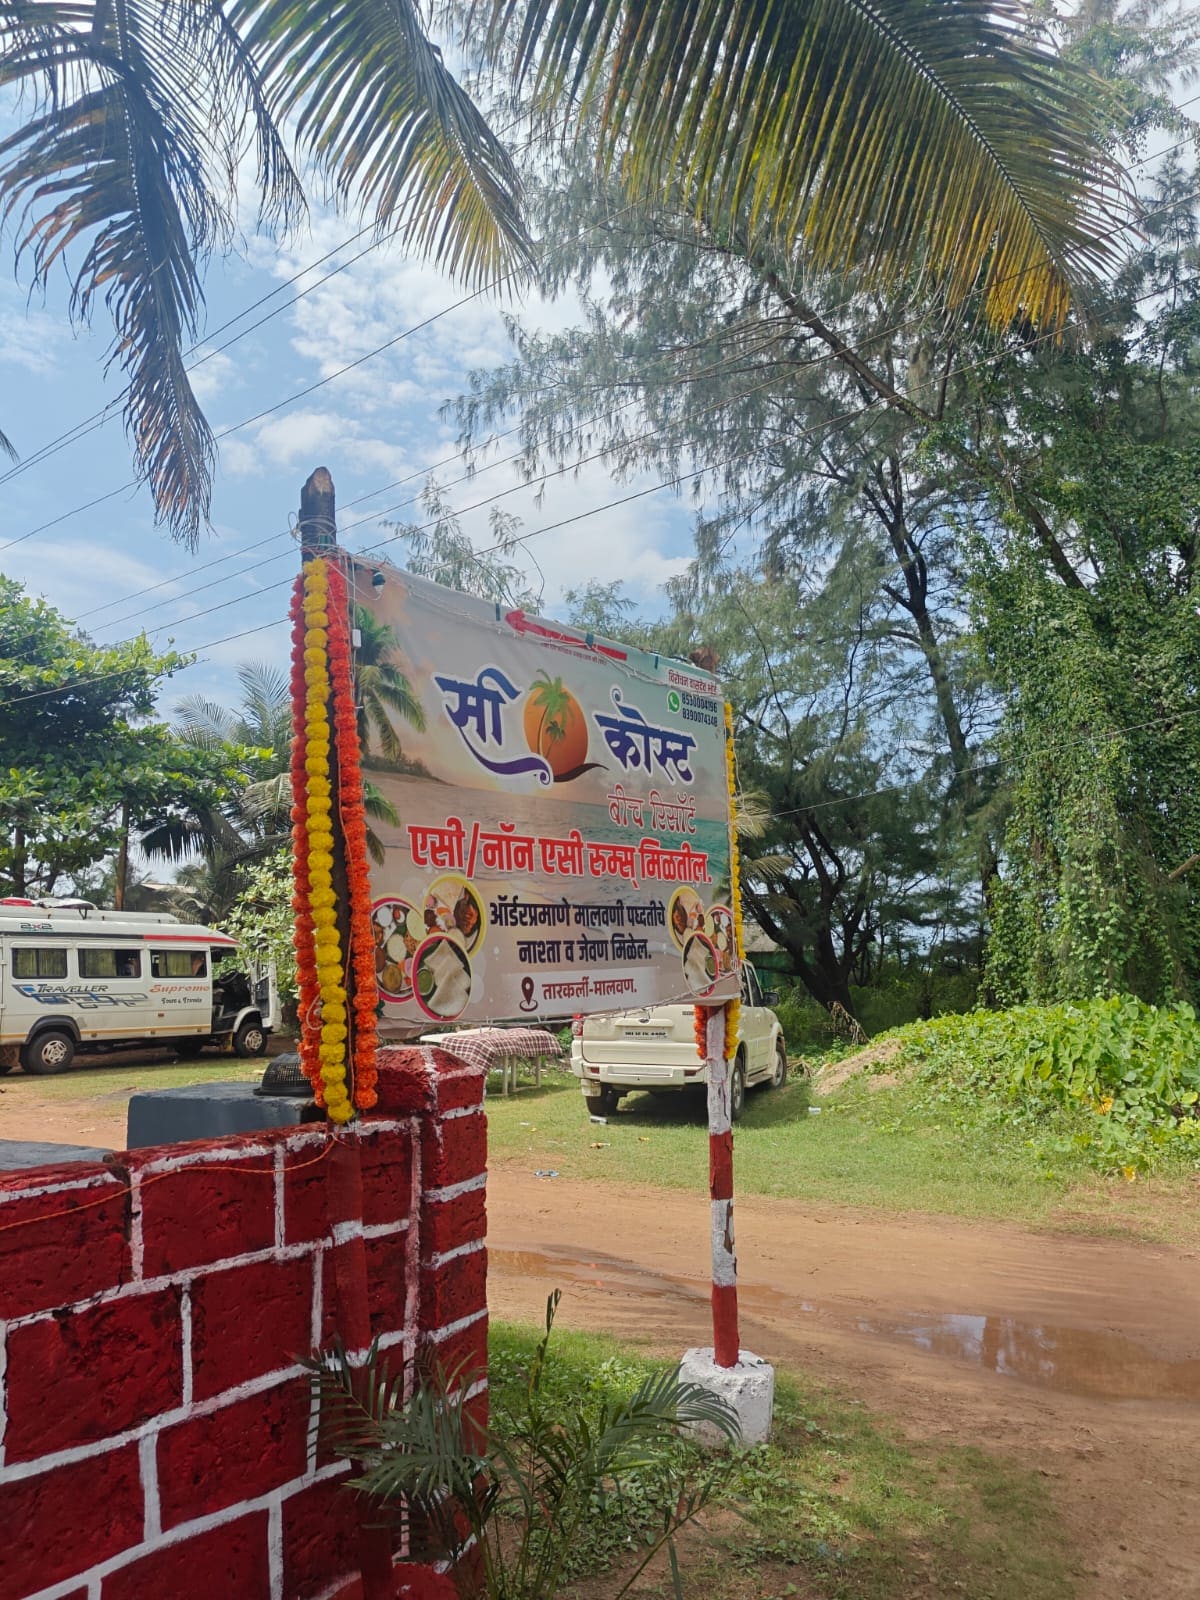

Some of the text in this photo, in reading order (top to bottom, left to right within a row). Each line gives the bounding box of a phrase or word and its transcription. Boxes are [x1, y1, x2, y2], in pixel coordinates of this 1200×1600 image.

[608, 784, 644, 828] बीच
[539, 829, 584, 875] एसी
[573, 899, 625, 927] मालवणी
[563, 940, 574, 962] व
[577, 933, 609, 962] जेवण
[610, 932, 652, 960] मिळेल.
